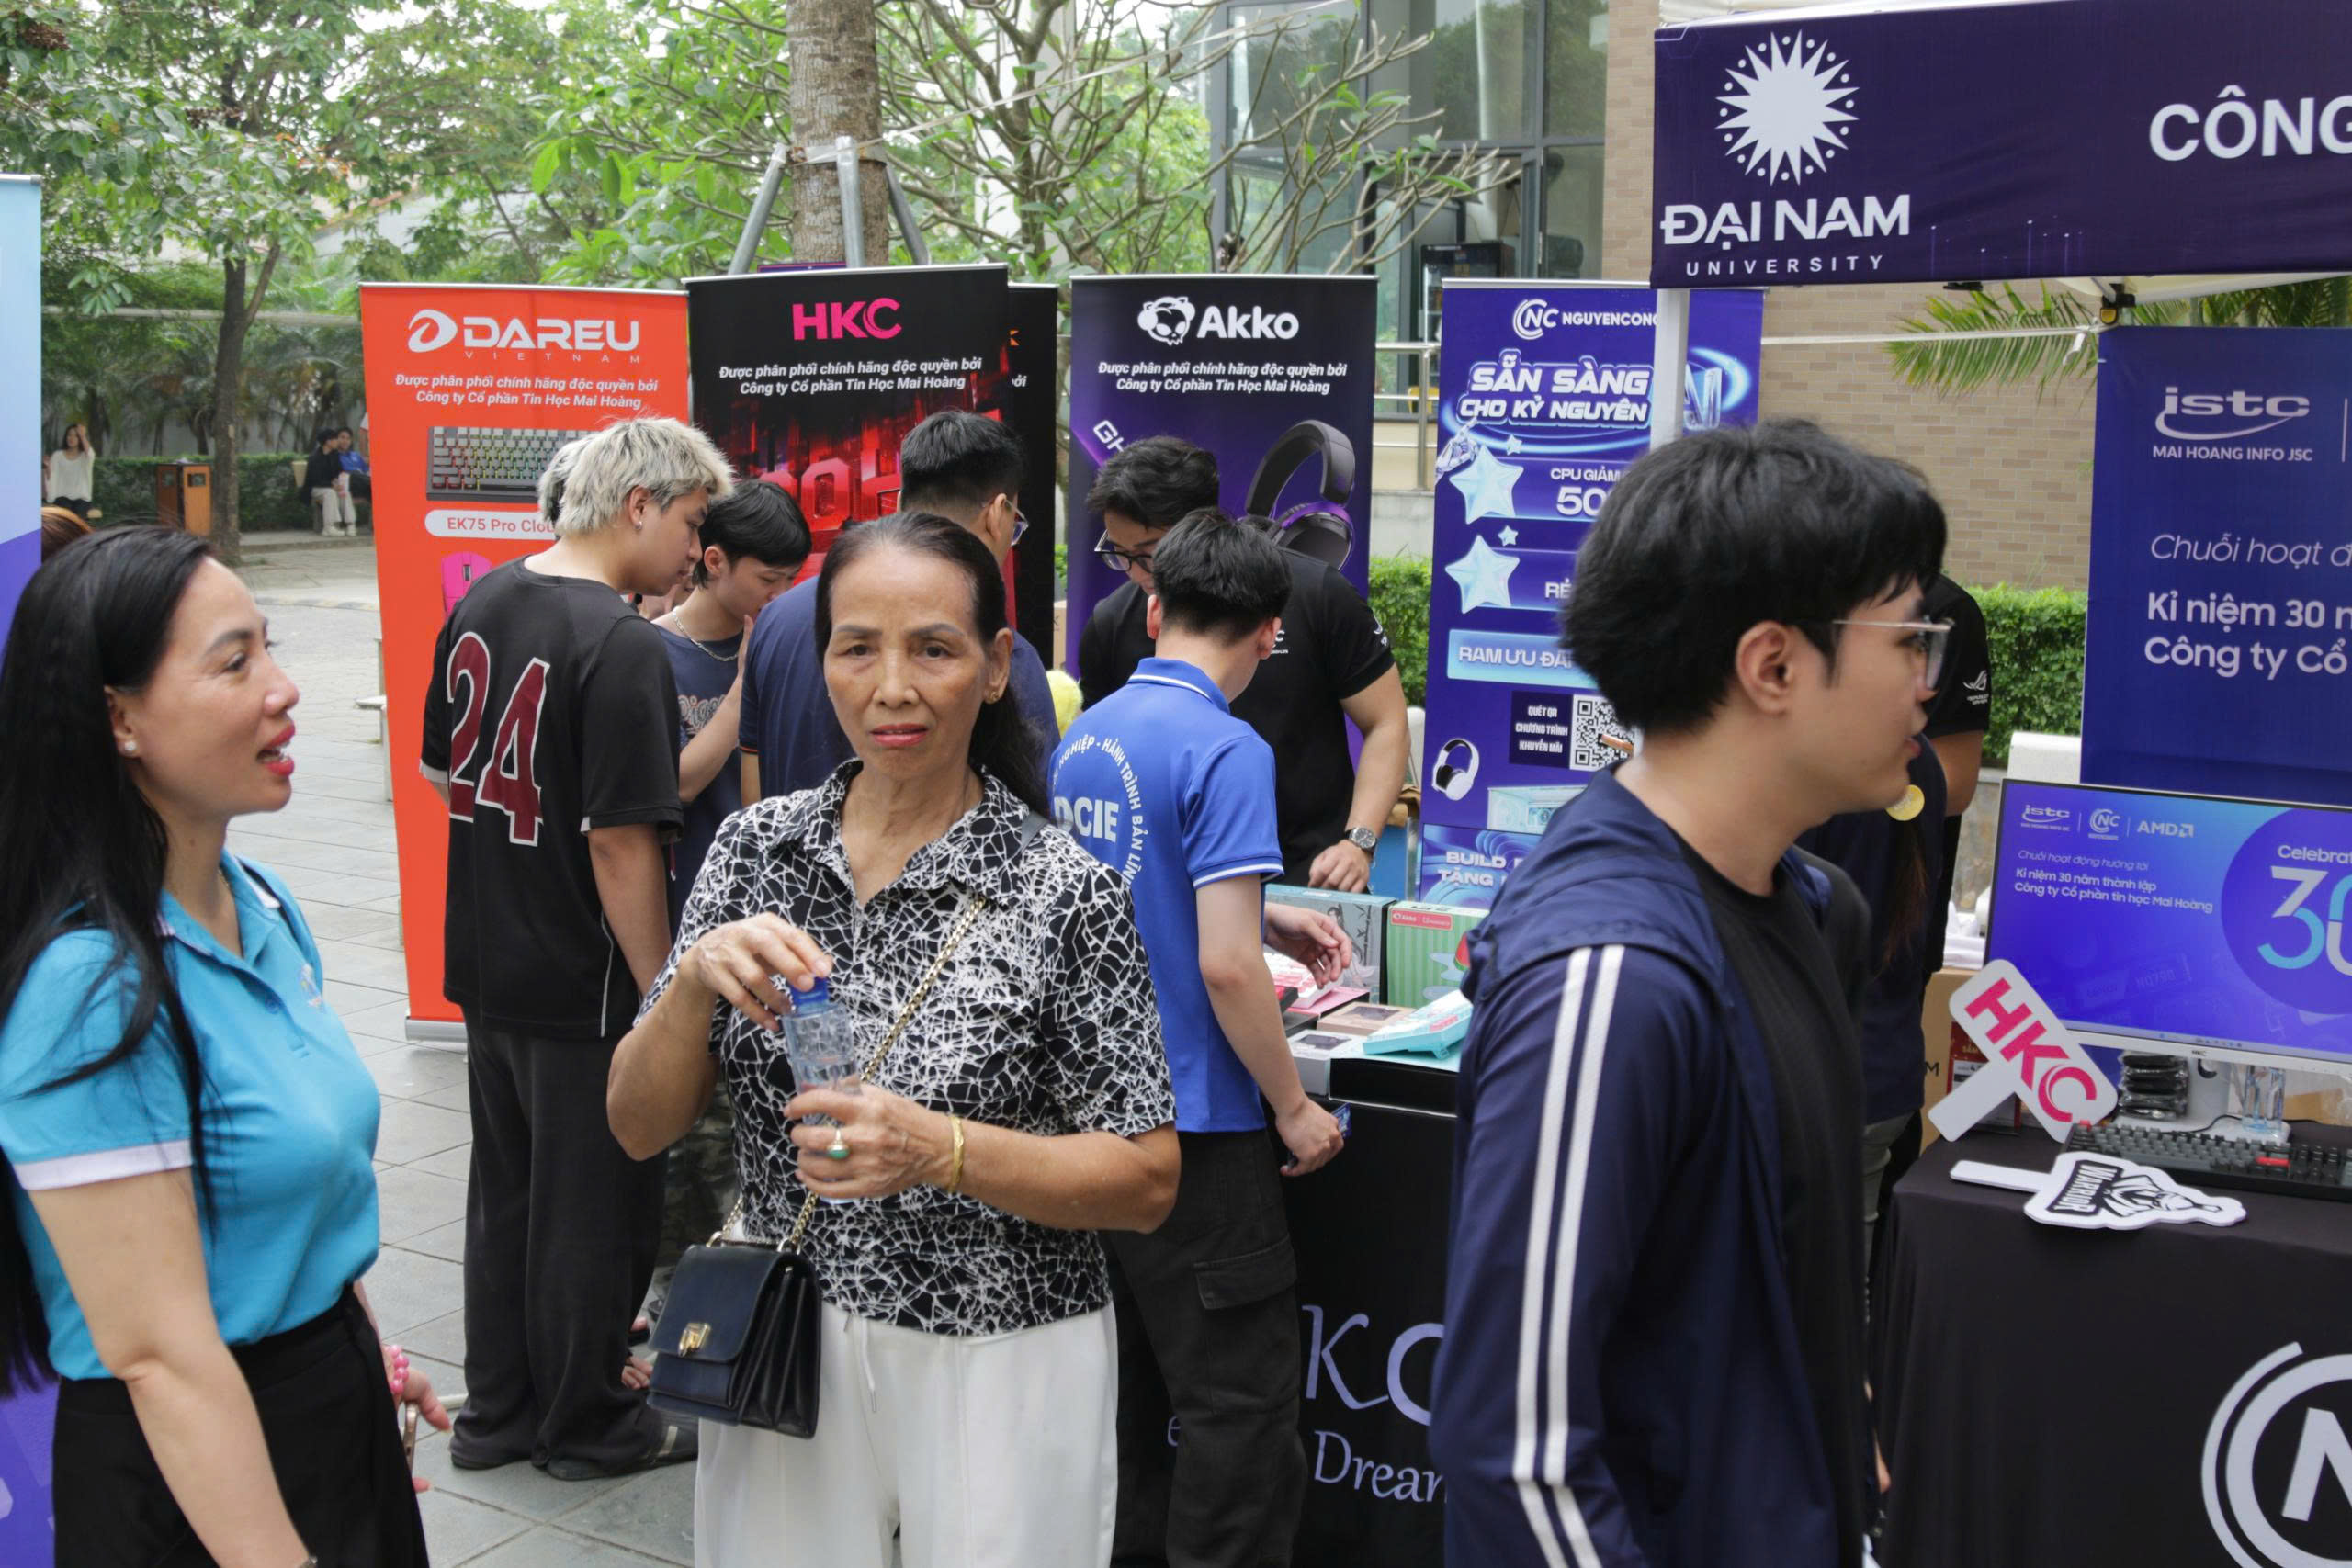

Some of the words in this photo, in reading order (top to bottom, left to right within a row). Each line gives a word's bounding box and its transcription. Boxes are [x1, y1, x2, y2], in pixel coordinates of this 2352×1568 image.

[2149, 85, 2352, 162] CÔNG
[1660, 202, 1762, 251] ĐẠI
[1774, 194, 1911, 242] NAM
[1686, 254, 1883, 276] UNIVERSITY
[792, 297, 902, 341] HKC
[1196, 305, 1300, 340] Akko
[463, 316, 640, 352] DAREU
[465, 353, 641, 365] VIETNAM
[719, 366, 752, 380] Được
[755, 364, 786, 379] phân
[789, 363, 818, 378] phối
[820, 361, 855, 375] chính
[857, 360, 889, 375] hãng
[892, 359, 917, 374] độc
[919, 358, 958, 374] quyền
[961, 356, 983, 370] bởi
[1098, 361, 1130, 377] Được
[1131, 361, 1161, 377] phân
[1163, 361, 1191, 377] phối
[1192, 362, 1226, 375] chính
[1228, 362, 1259, 378] hãng
[1261, 362, 1284, 378] độc
[1286, 362, 1324, 378] quyền
[1326, 362, 1348, 376] bởi
[395, 373, 429, 388] Được
[432, 375, 463, 389] phân
[466, 375, 493, 389] phối
[496, 376, 531, 389] chính
[535, 377, 566, 391] hãng
[569, 378, 594, 392] độc
[596, 378, 635, 393] quyền
[638, 378, 659, 391] bởi
[1471, 354, 1543, 393] SẴN
[1551, 361, 1650, 395] SÀNG
[741, 382, 774, 396] Công
[775, 381, 788, 396] ty
[791, 378, 809, 393] Cổ
[810, 378, 842, 394] phần
[845, 378, 865, 391] Tin
[868, 378, 893, 392] Học
[897, 377, 921, 389] Mai
[923, 376, 967, 390] Hoàng
[1116, 378, 1148, 393] Công
[1150, 378, 1162, 393] ty
[1164, 378, 1182, 391] Cổ
[1182, 378, 1213, 393] phần
[1216, 379, 1235, 391] Tin
[1237, 379, 1262, 394] Học
[1264, 379, 1288, 392] Mai
[1290, 379, 1330, 395] Hoàng
[416, 390, 449, 405] Công
[452, 392, 465, 405] ty
[487, 392, 519, 406] phần
[522, 393, 542, 405] Tin
[545, 394, 571, 408] Học
[573, 395, 597, 407] Mai
[600, 395, 641, 410] Hoàng
[1459, 398, 1508, 417] CHO
[1512, 394, 1545, 419] KỶ
[1549, 397, 1648, 421] NGUYÊN
[2161, 387, 2310, 424] istc
[2153, 446, 2182, 458] MAI
[2186, 446, 2243, 460] HOANG
[2247, 447, 2285, 460] INFO
[2288, 448, 2313, 461] JSC
[1550, 467, 1582, 480] CPU
[1583, 465, 1621, 482] GIẢM
[1556, 486, 1612, 516] 50
[447, 517, 486, 531] EK75
[491, 518, 516, 532] Pro
[2151, 532, 2241, 562] Chuỗi
[2246, 537, 2324, 570] hoạt
[2148, 590, 2178, 621] Kỉ
[2186, 592, 2276, 633] niệm
[2285, 599, 2325, 628] 30
[1459, 646, 1502, 663] RAM
[1505, 649, 1537, 666] ƯU
[2144, 635, 2241, 678] Công
[2250, 641, 2288, 680] ty
[2297, 638, 2348, 675] Cổ
[1528, 705, 1546, 716] QUÉT
[1547, 707, 1558, 717] QR
[447, 631, 550, 847] 24
[1546, 724, 1568, 736] TRÌNH
[1102, 738, 1126, 767] HÀNH
[1120, 761, 1142, 811] TRÌNH
[1131, 815, 1148, 851] BẢN
[2137, 820, 2178, 836] AMD
[1445, 851, 1507, 869] BUILD
[1437, 867, 1494, 886] TẶNG
[2058, 872, 2072, 882] 30
[2047, 885, 2059, 897] ty
[2111, 891, 2126, 902] tin
[2153, 896, 2174, 907] Mai
[1965, 977, 2098, 1123] HKC
[2052, 1164, 2118, 1213] WARRIOR
